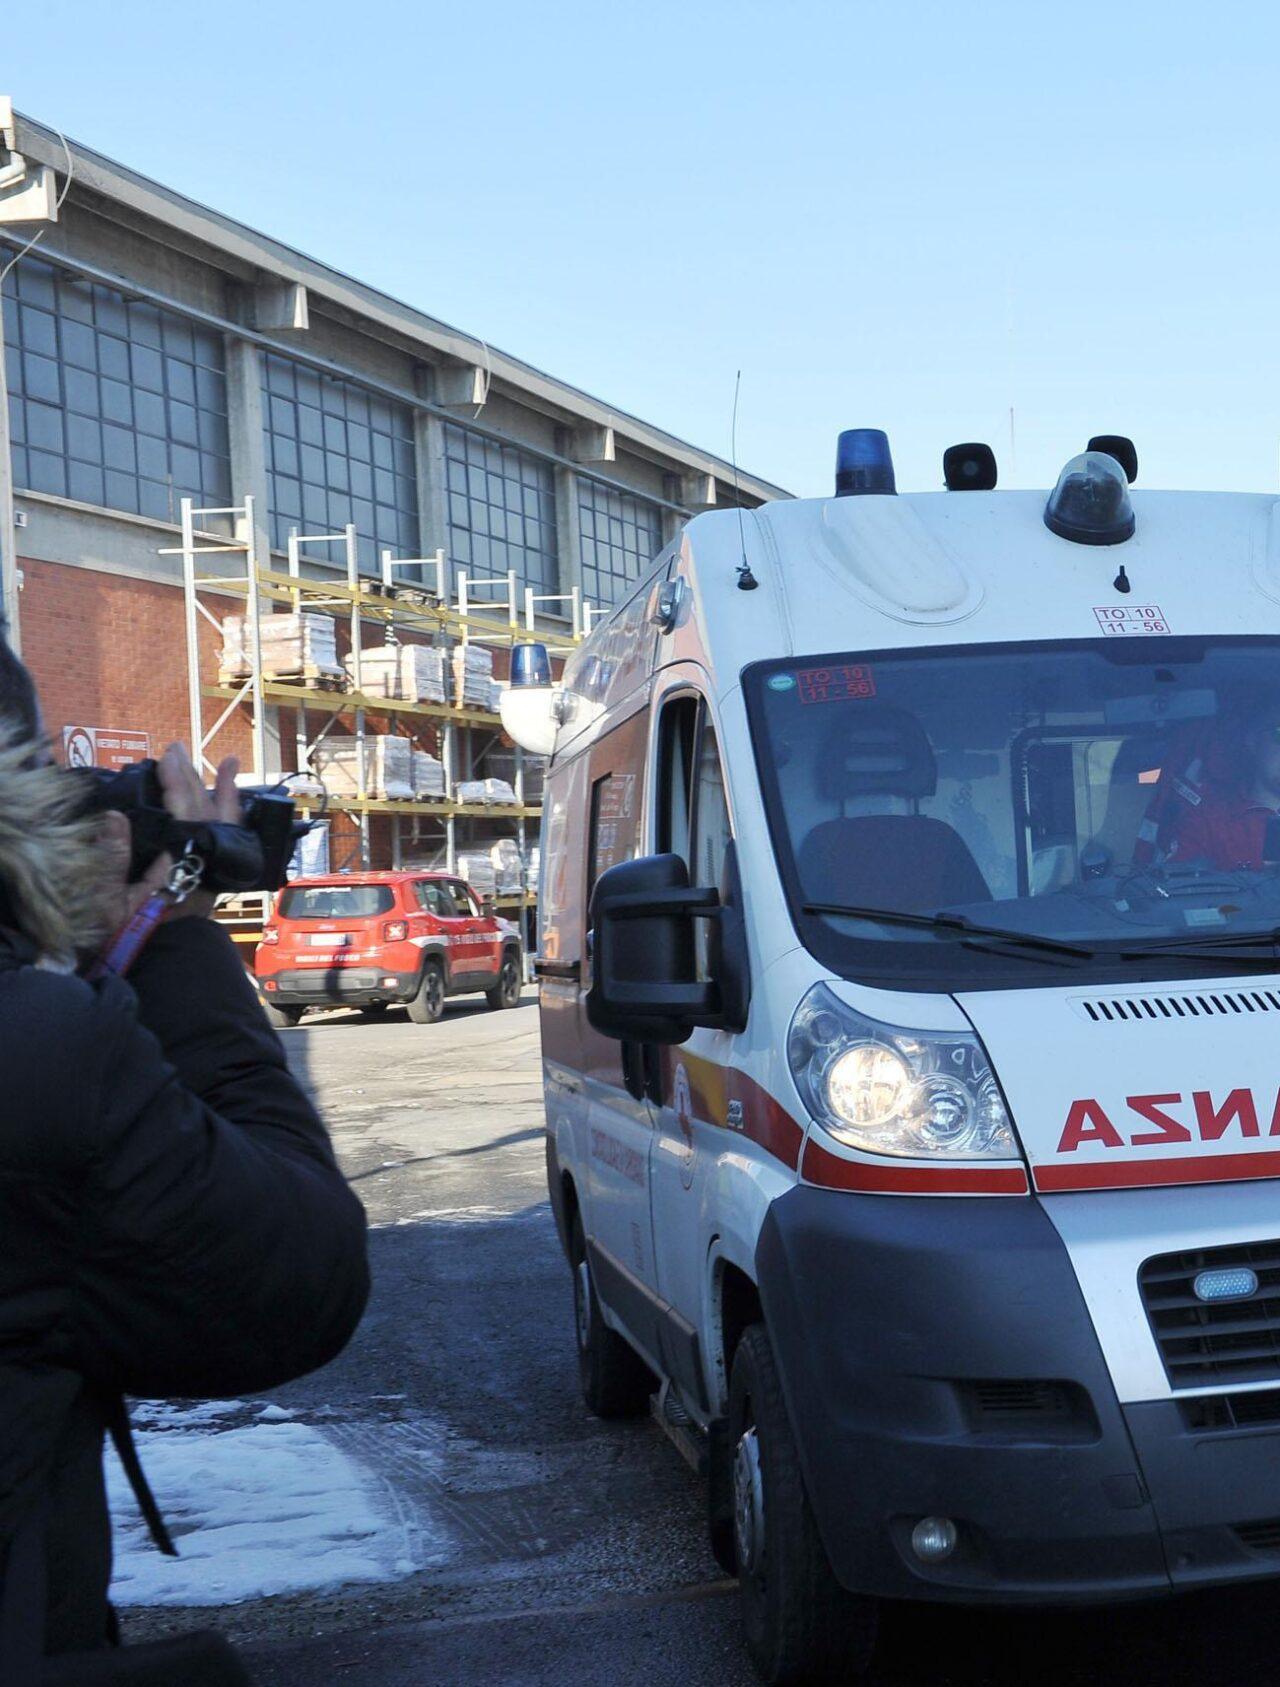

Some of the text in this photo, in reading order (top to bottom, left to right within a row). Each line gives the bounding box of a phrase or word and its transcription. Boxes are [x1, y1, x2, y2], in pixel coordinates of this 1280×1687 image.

[1098, 608, 1156, 620] TO 10
[1107, 623, 1126, 633] 11
[1143, 621, 1164, 632] 56
[801, 671, 830, 686] TO
